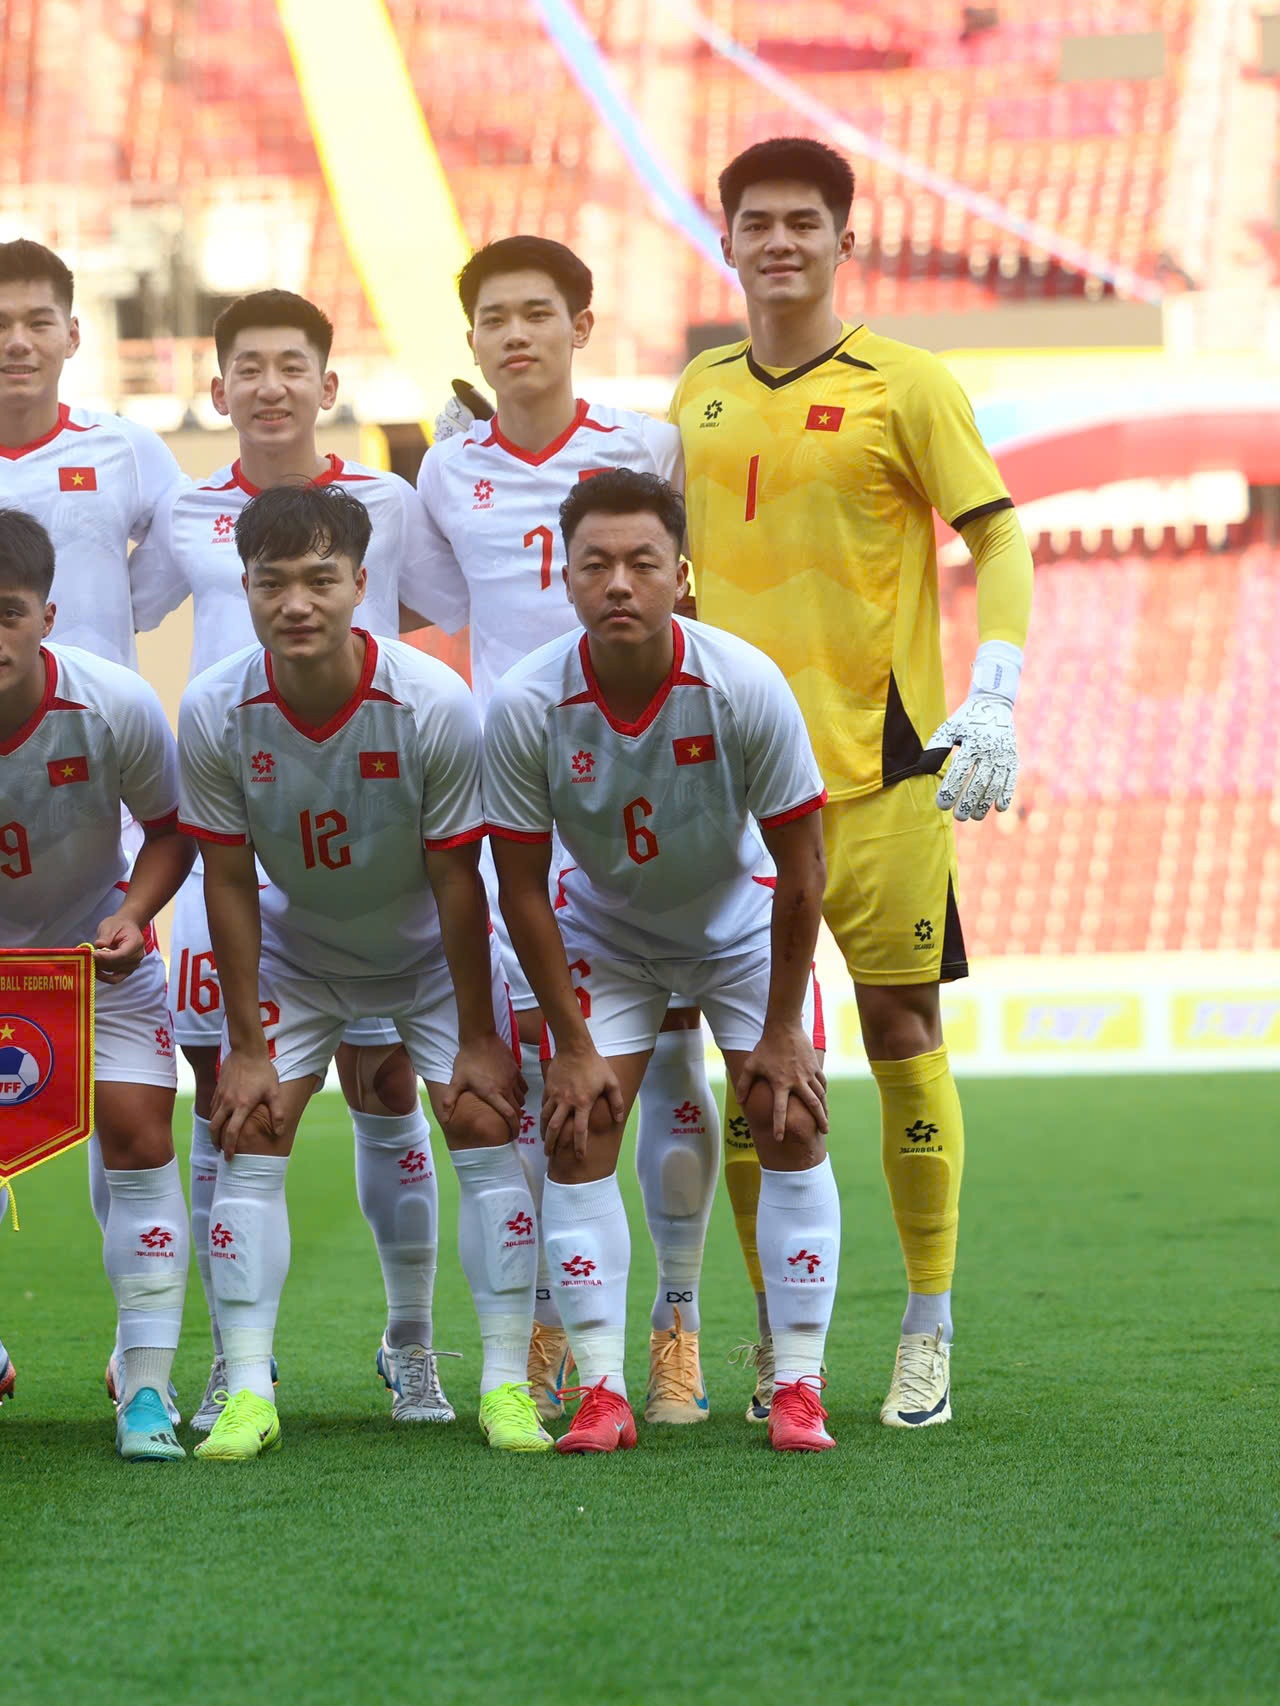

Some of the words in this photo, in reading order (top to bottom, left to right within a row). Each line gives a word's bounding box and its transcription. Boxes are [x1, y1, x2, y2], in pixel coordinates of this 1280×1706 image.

[523, 524, 554, 590] 7
[300, 808, 352, 871] 12
[624, 797, 659, 865] 6
[23, 974, 74, 992] FEDERATION
[176, 947, 220, 1016] 16
